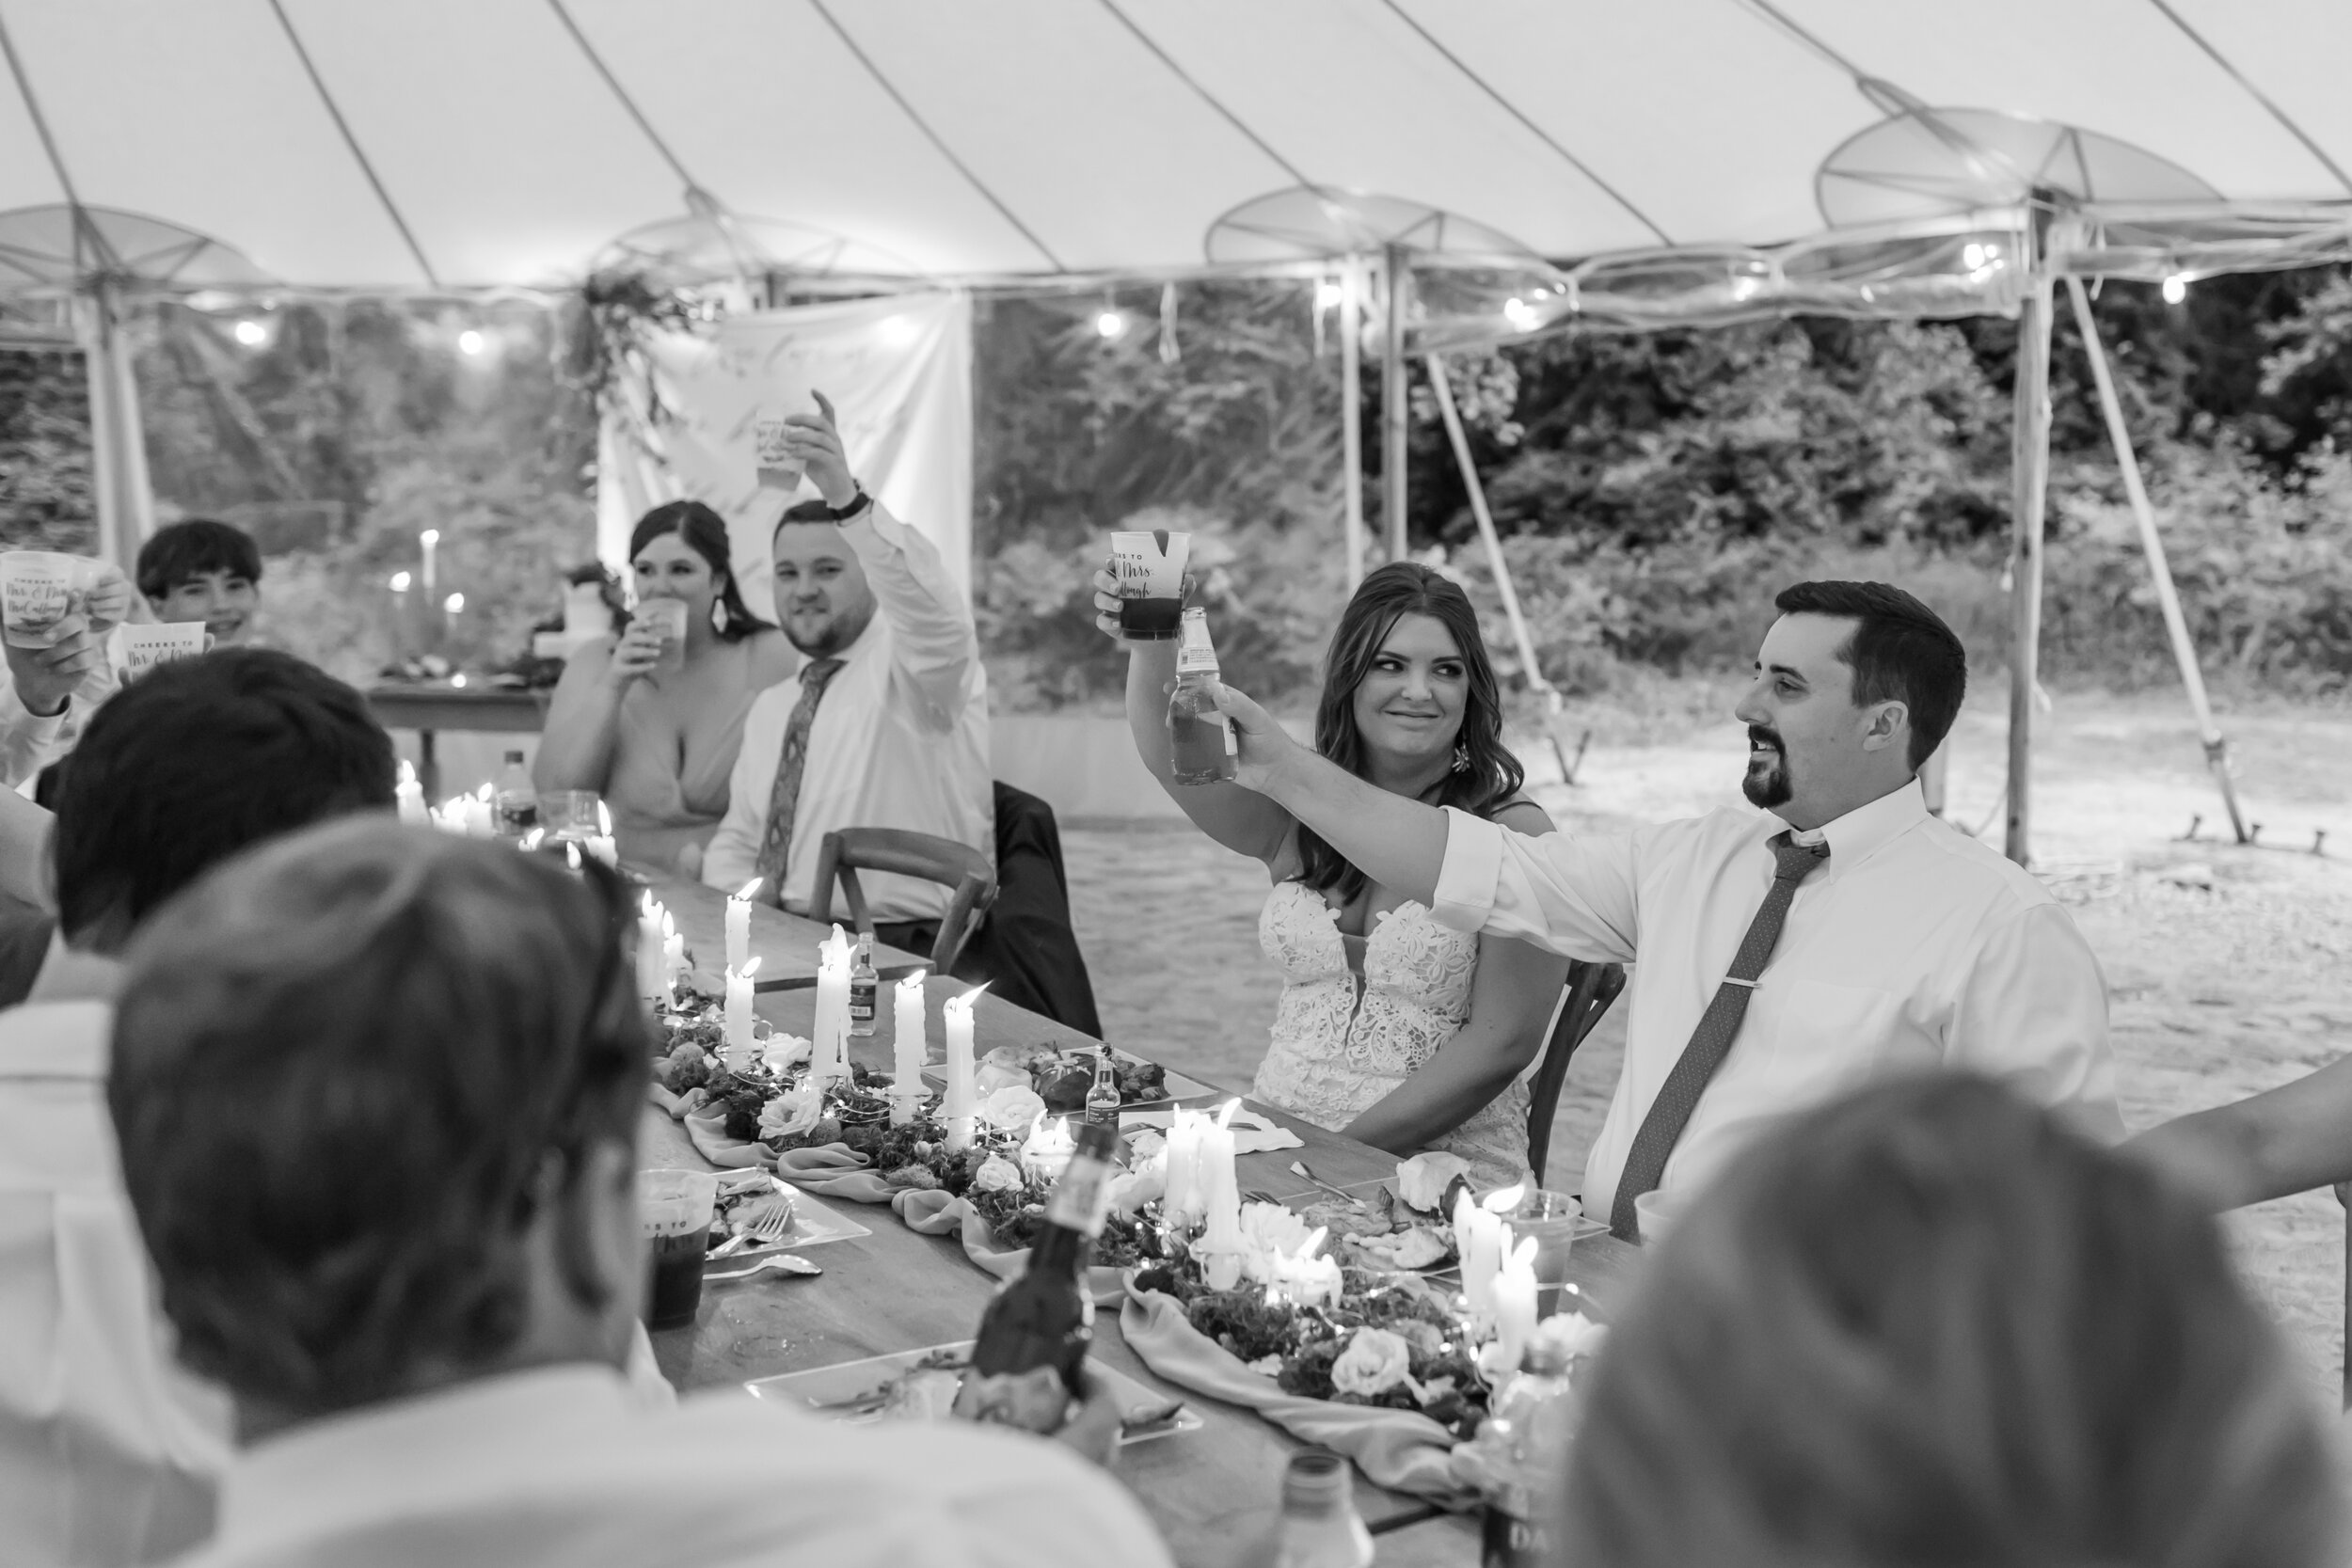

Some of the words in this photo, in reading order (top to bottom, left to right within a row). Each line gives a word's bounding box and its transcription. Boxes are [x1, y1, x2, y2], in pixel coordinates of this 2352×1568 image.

[1122, 561, 1152, 578] Mrs
[134, 641, 177, 649] CHEERS
[671, 1220, 687, 1229] TO
